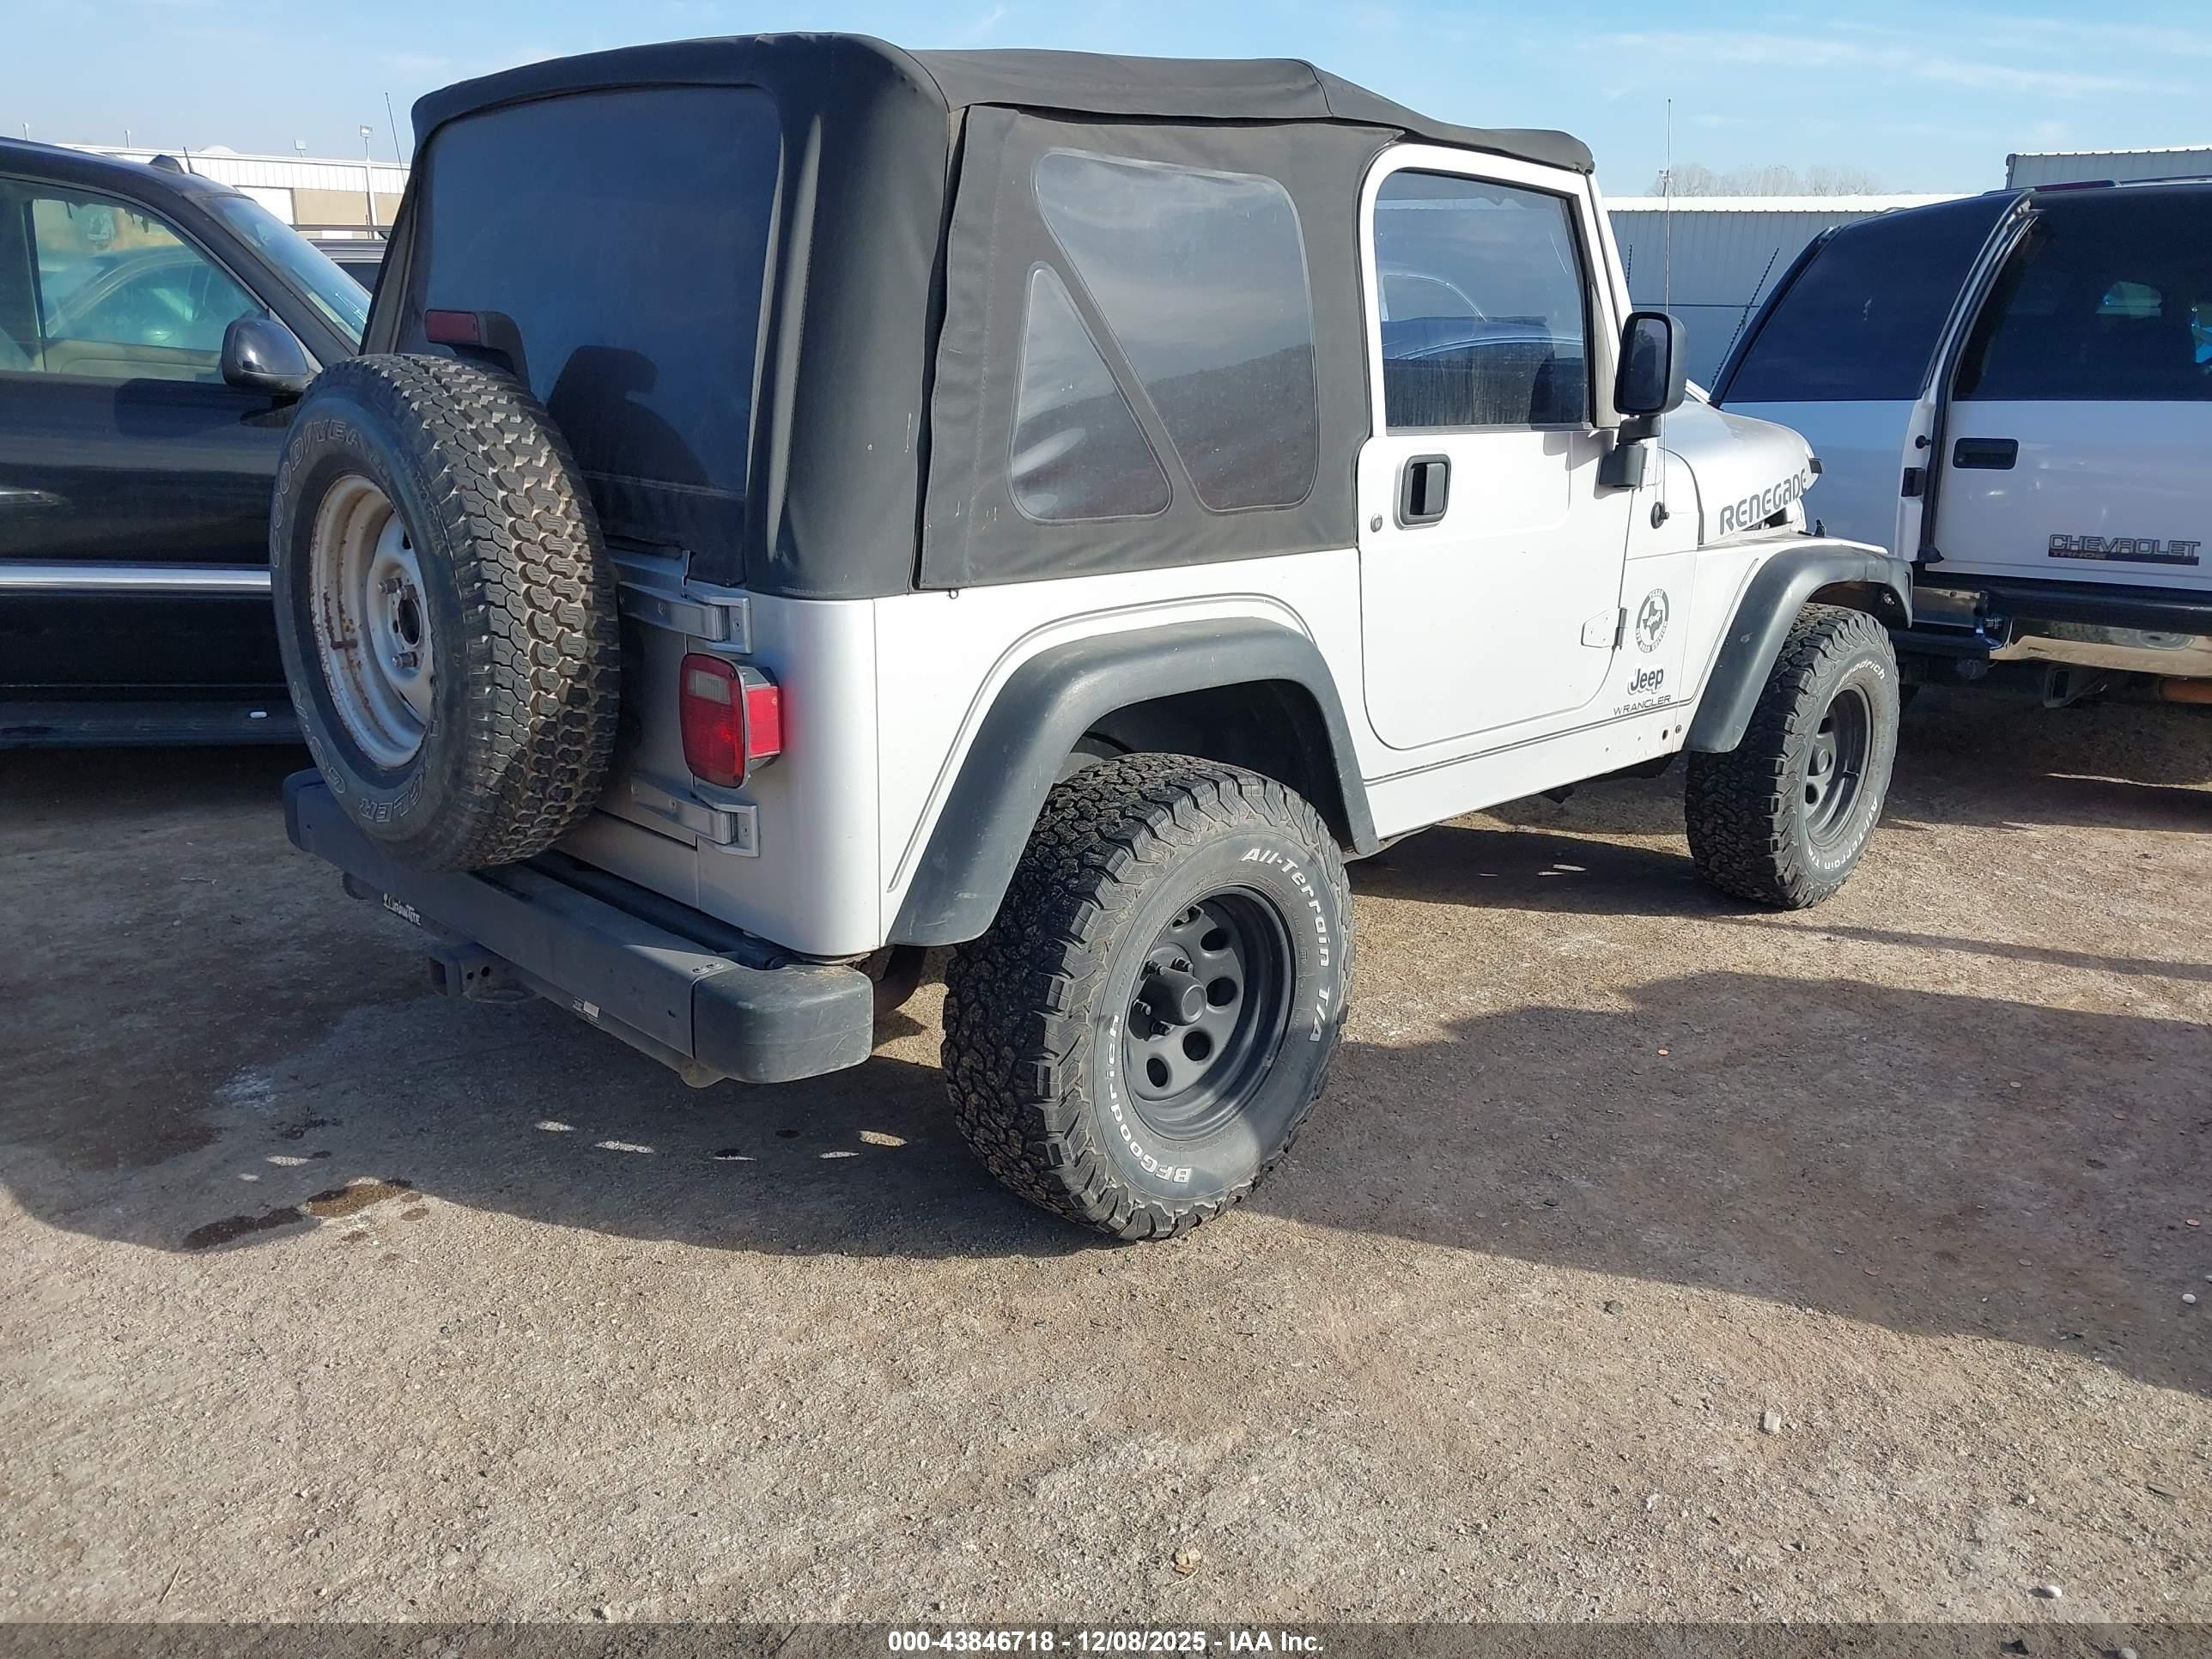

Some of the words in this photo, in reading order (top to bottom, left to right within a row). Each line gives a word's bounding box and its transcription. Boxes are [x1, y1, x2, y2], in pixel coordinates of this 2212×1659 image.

[269, 419, 378, 568] GOODYEA
[2049, 533, 2201, 557] CHEVROLET
[1613, 694, 1672, 716] WRANGLER
[1629, 666, 1664, 693] Jeep
[1823, 795, 1878, 872] All-Terrain
[1241, 847, 1330, 967] All-Terrain
[1308, 986, 1330, 1042] T/A
